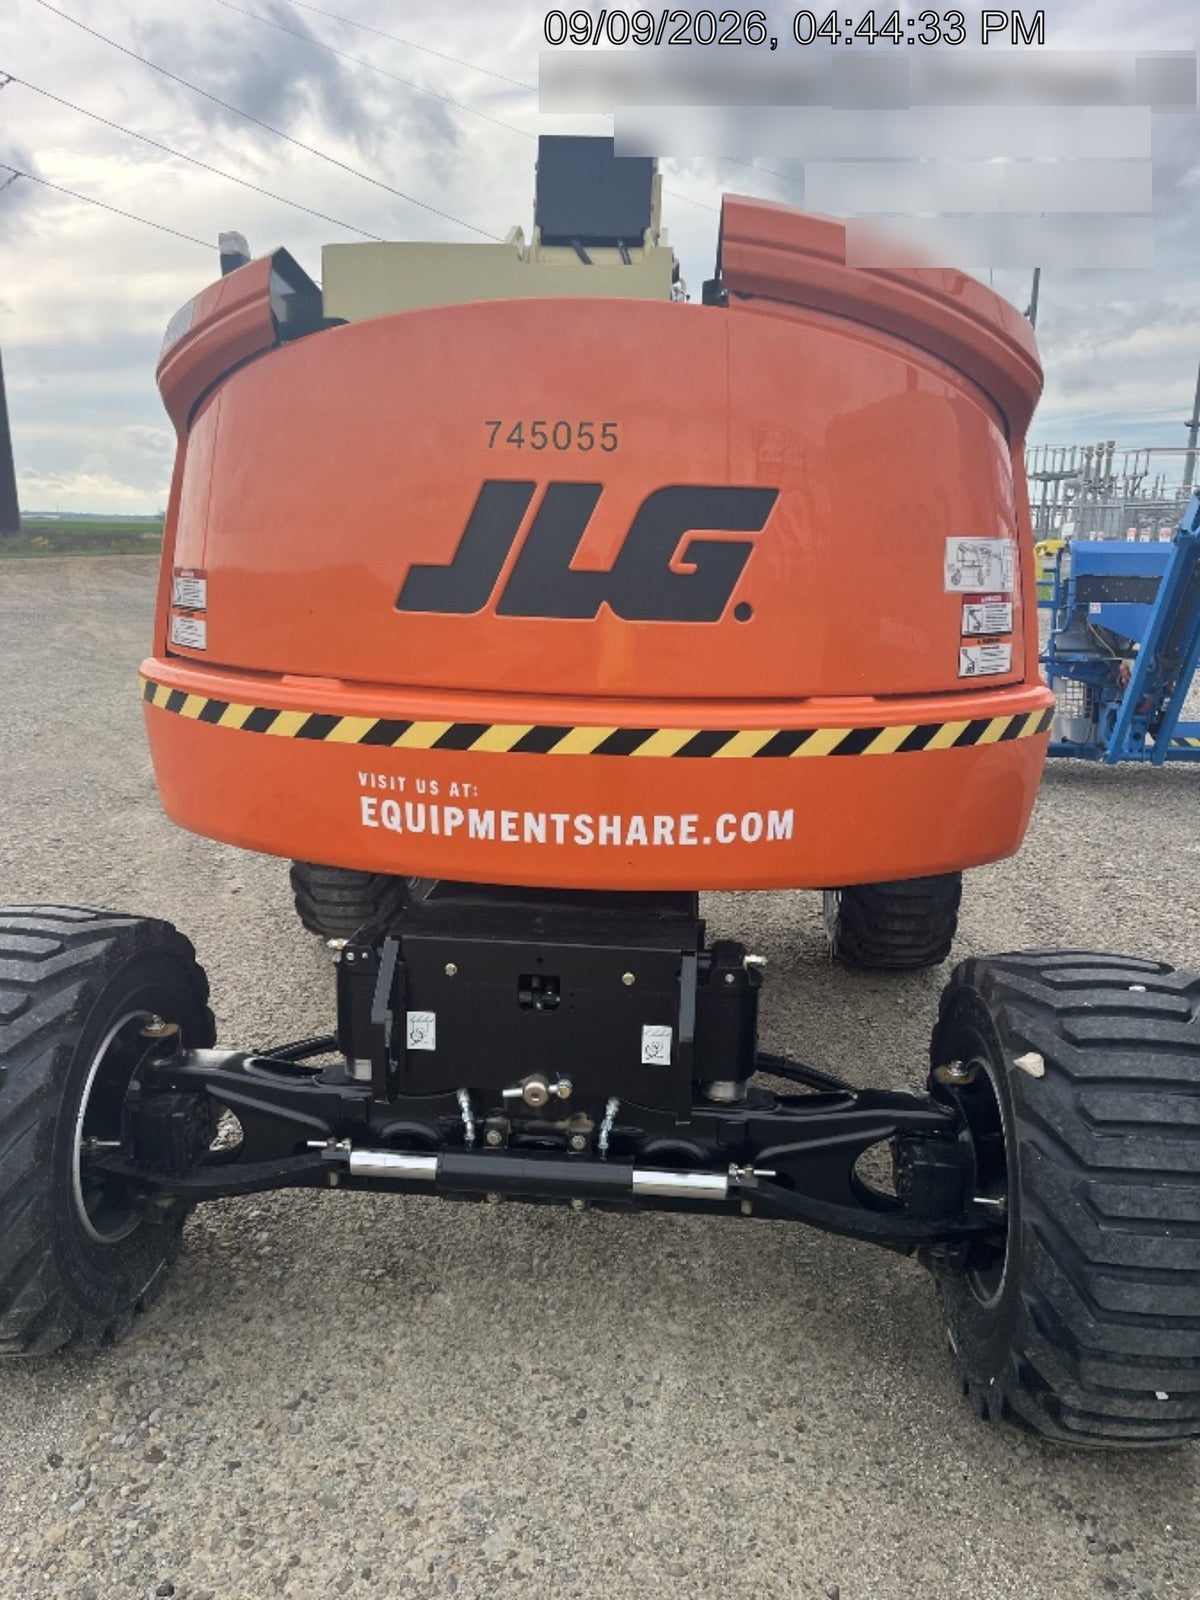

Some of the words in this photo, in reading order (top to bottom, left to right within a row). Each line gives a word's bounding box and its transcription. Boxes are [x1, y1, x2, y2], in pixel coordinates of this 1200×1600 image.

[485, 421, 619, 452] 745055
[358, 771, 406, 792] VISIT
[415, 778, 440, 796] US
[449, 781, 479, 797] AT:
[360, 796, 795, 846] EQUIPMENTSHARE.COM
